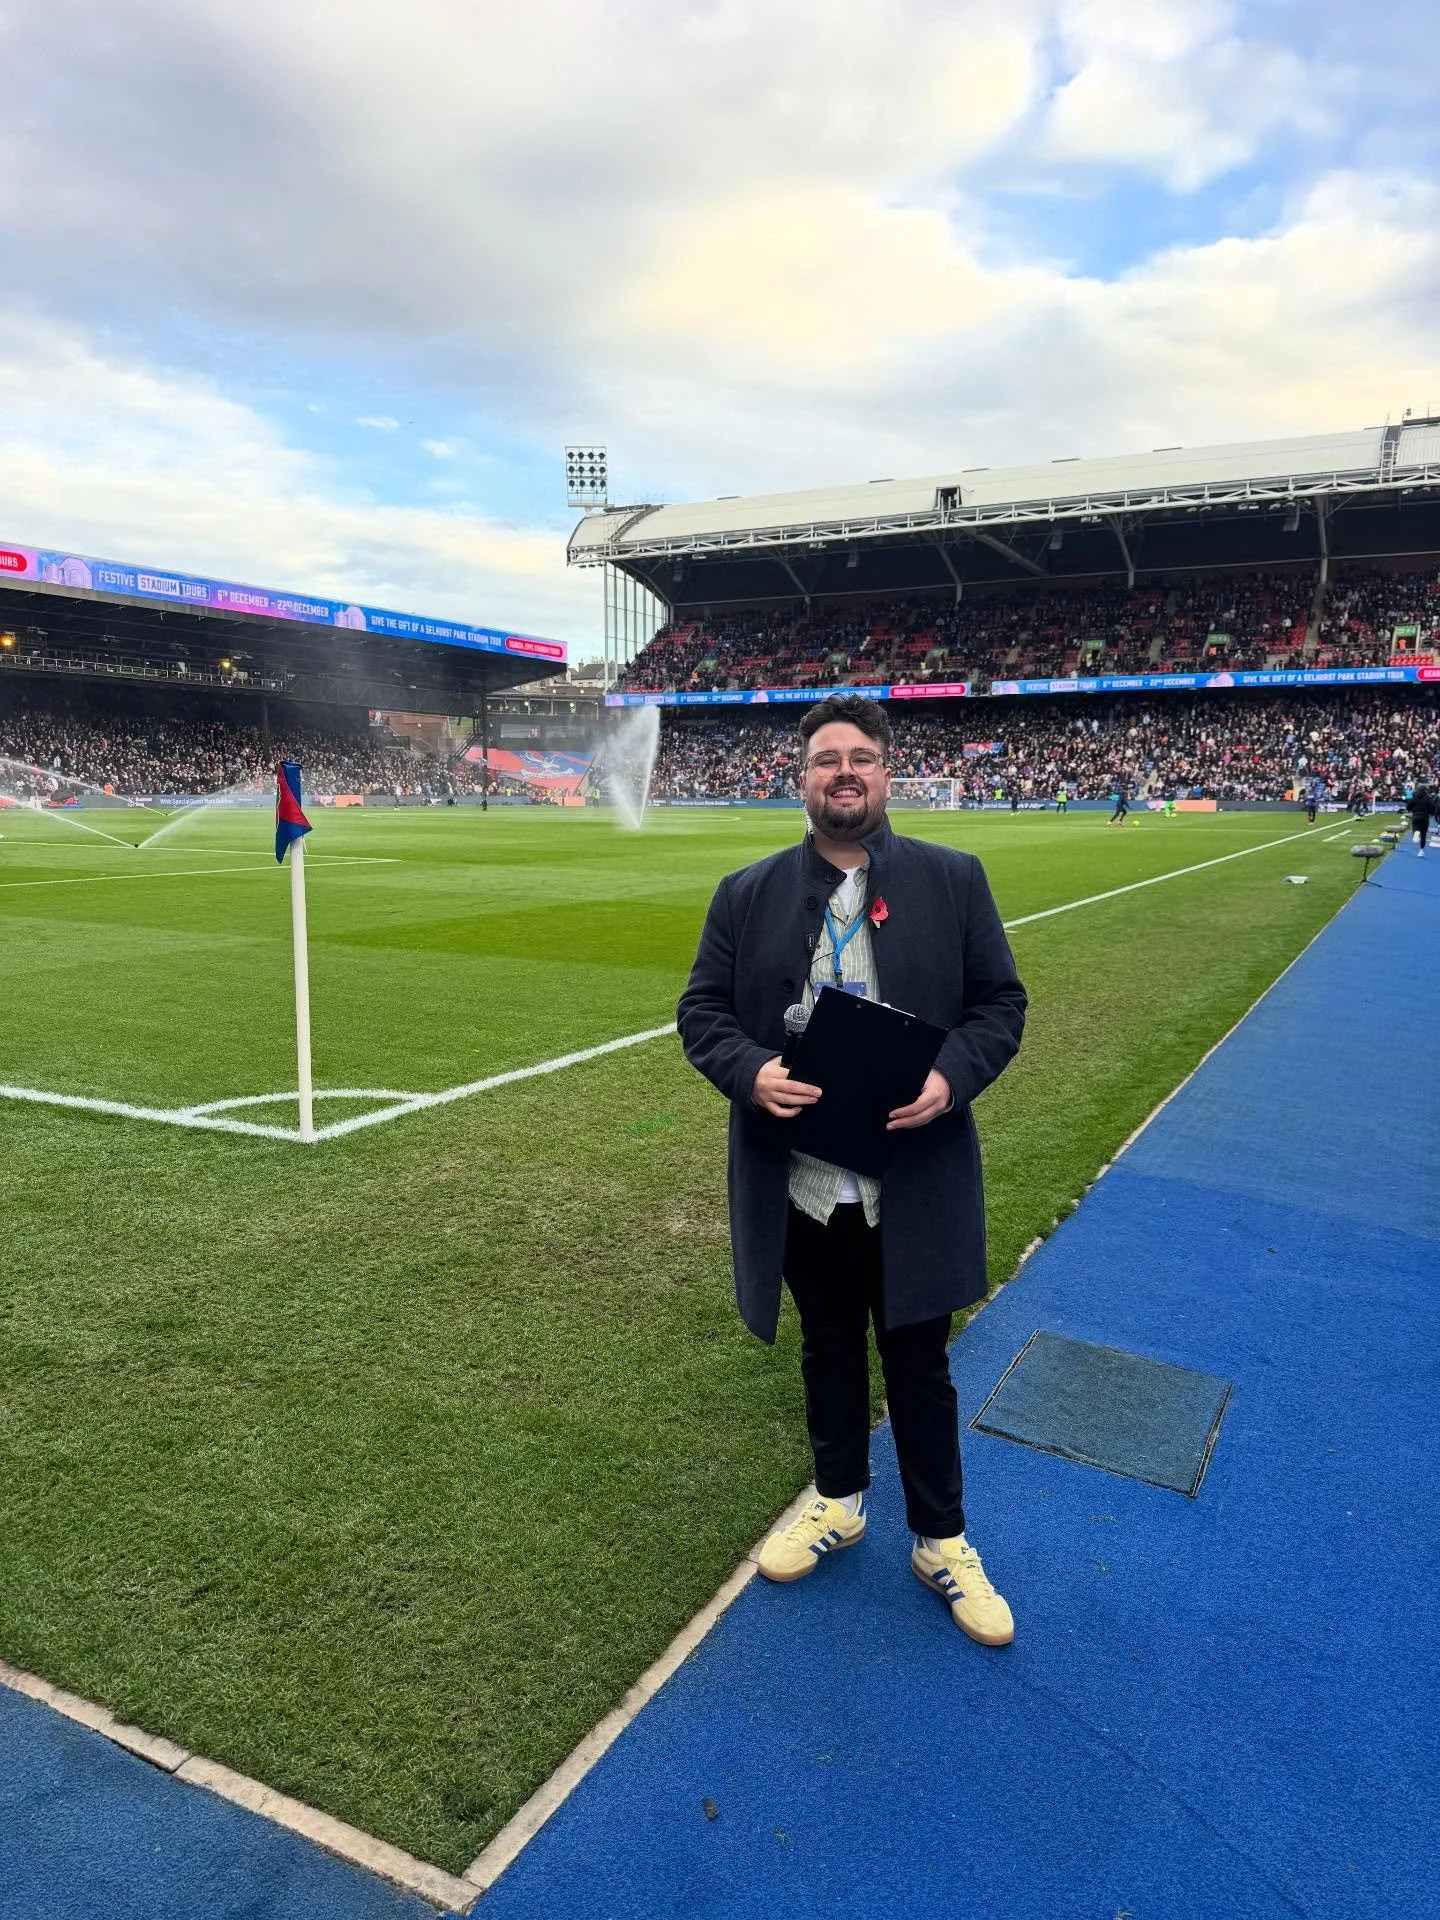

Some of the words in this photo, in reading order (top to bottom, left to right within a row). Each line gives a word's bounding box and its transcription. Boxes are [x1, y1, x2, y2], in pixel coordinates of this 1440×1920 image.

[0, 556, 18, 568] URS
[98, 570, 135, 587] FESTIVE
[140, 577, 177, 593] STADIUM
[182, 583, 207, 598] TOURS
[230, 591, 269, 608] DECEMBER
[294, 601, 329, 617] DECEMBER
[371, 615, 385, 627] GIVE
[386, 617, 397, 629] THE
[398, 618, 411, 631] GIFT
[412, 621, 420, 632] OF
[420, 623, 425, 634] A
[426, 624, 452, 638] SELHURST
[453, 629, 467, 641] PARK
[467, 631, 489, 645] STADIUM
[1112, 679, 1143, 688] DECEMBER
[1164, 677, 1196, 686] DECEMBER
[1243, 675, 1257, 683] GIVE
[1259, 675, 1271, 683] THE
[1272, 674, 1286, 683] GIFT
[1287, 674, 1296, 682] OF
[1297, 673, 1302, 682] A
[1304, 673, 1336, 682] SELHURST
[1337, 672, 1355, 681] PARK
[1357, 671, 1386, 680] STADIUM
[1388, 670, 1405, 679] TOUR
[1026, 682, 1049, 691] FESTIVE
[1051, 681, 1076, 690] STADIUM
